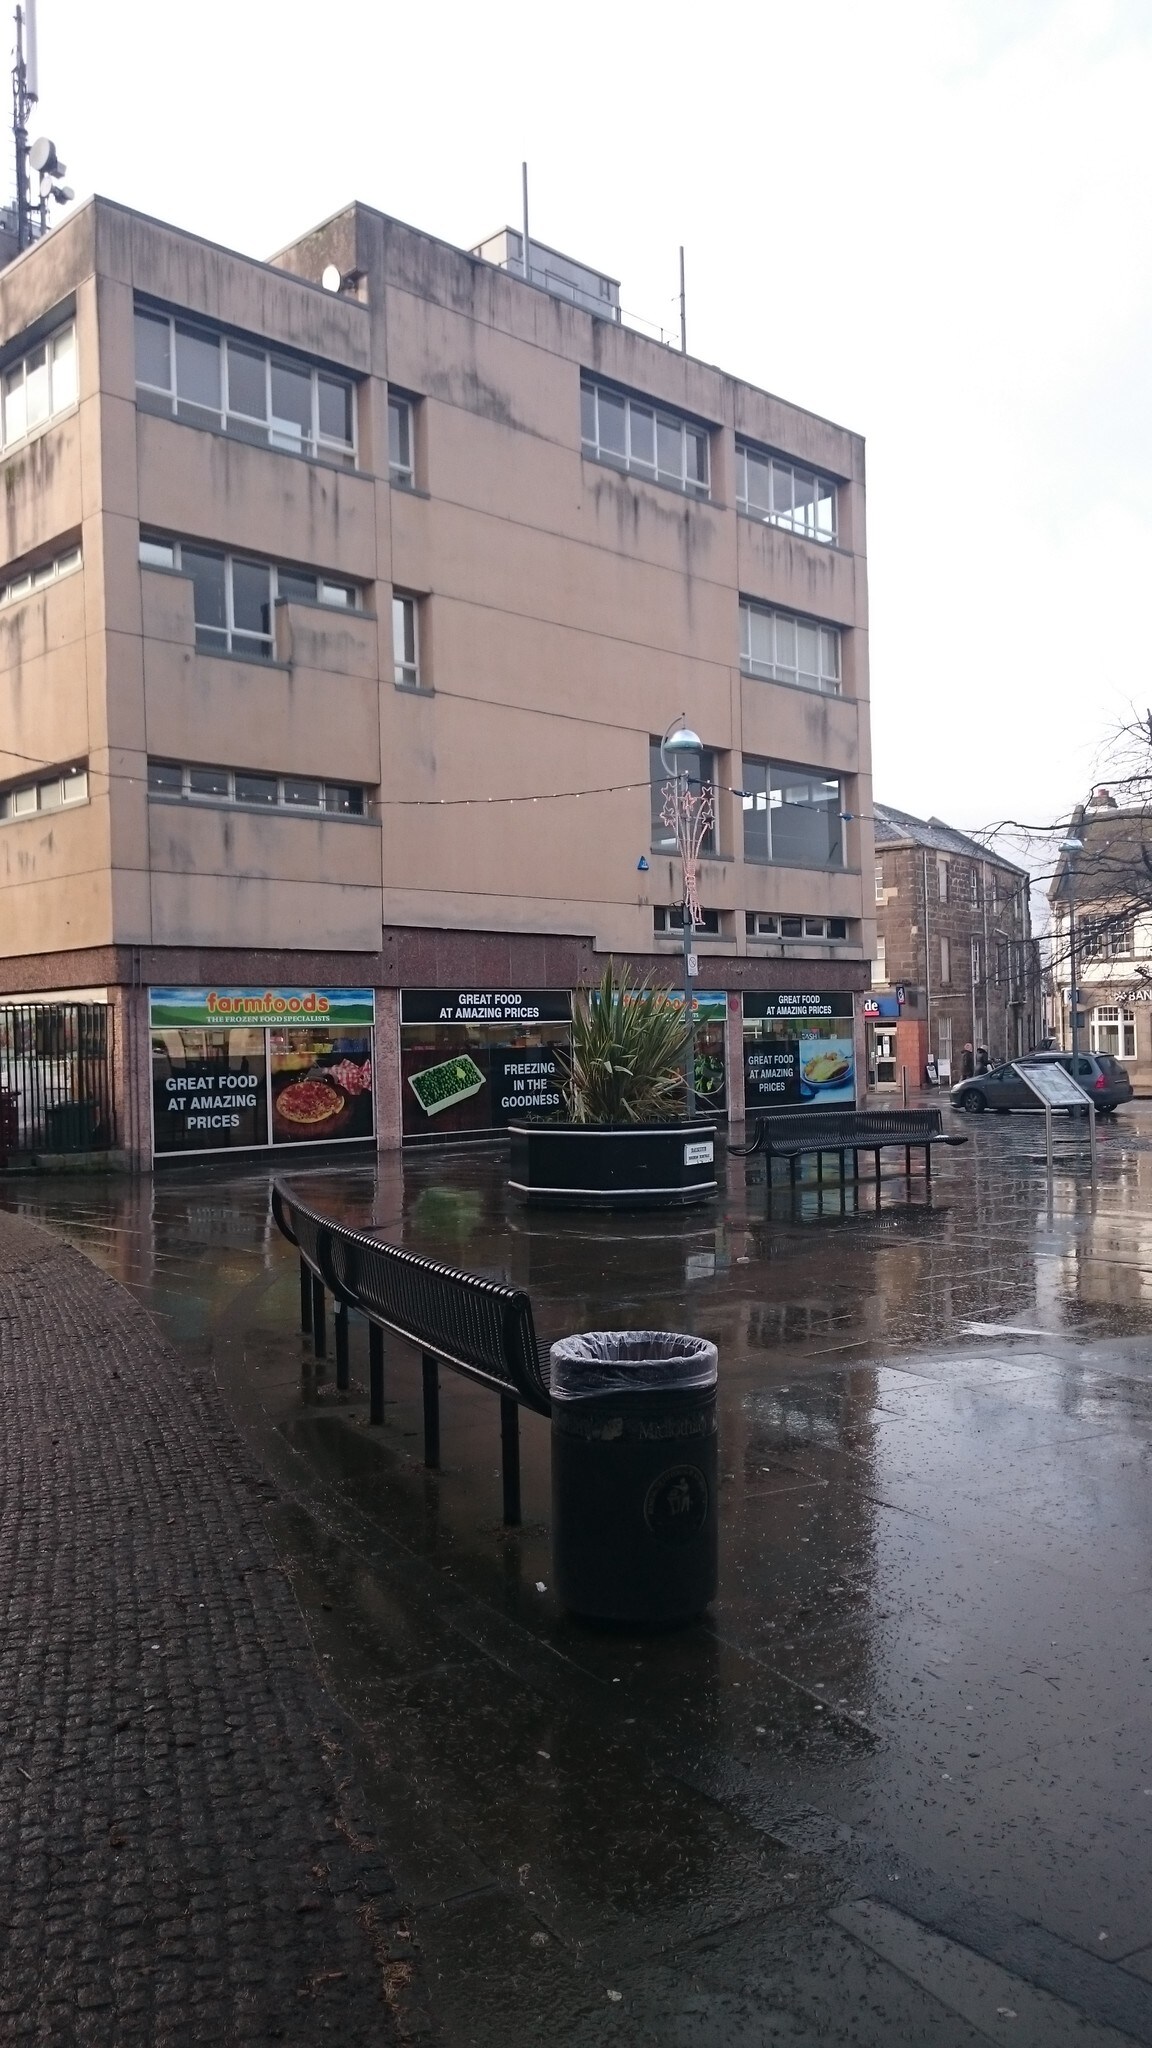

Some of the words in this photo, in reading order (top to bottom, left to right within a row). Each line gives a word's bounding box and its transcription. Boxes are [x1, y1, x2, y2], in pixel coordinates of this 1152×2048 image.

[206, 991, 330, 1013] farmfoods
[458, 994, 492, 1005] GREAT
[494, 994, 522, 1005] FOOD
[778, 995, 801, 1004] GREAT
[802, 995, 820, 1004] FOOD
[440, 1008, 453, 1018] AT
[455, 1007, 502, 1018] AMAZING
[504, 1007, 539, 1018] PRICES
[766, 1006, 776, 1015] AT
[776, 1006, 807, 1015] AMAZING
[808, 1005, 832, 1014] PRICES
[225, 1015, 258, 1023] FROZEN
[260, 1015, 283, 1023] FOOD
[748, 1055, 772, 1065] GREAT
[774, 1054, 794, 1064] FOOD
[504, 1062, 556, 1075] FREEZING
[749, 1069, 758, 1079] AT
[760, 1067, 794, 1079] AMAZING
[165, 1076, 214, 1091] GREAT
[219, 1075, 258, 1089] FOOD
[513, 1079, 524, 1091] IN
[527, 1078, 547, 1090] THE
[759, 1081, 786, 1092] PRICES
[168, 1098, 186, 1111] AT
[190, 1094, 257, 1110] AMAZING
[501, 1093, 560, 1108] GOODNESS
[187, 1114, 240, 1130] PRICES
